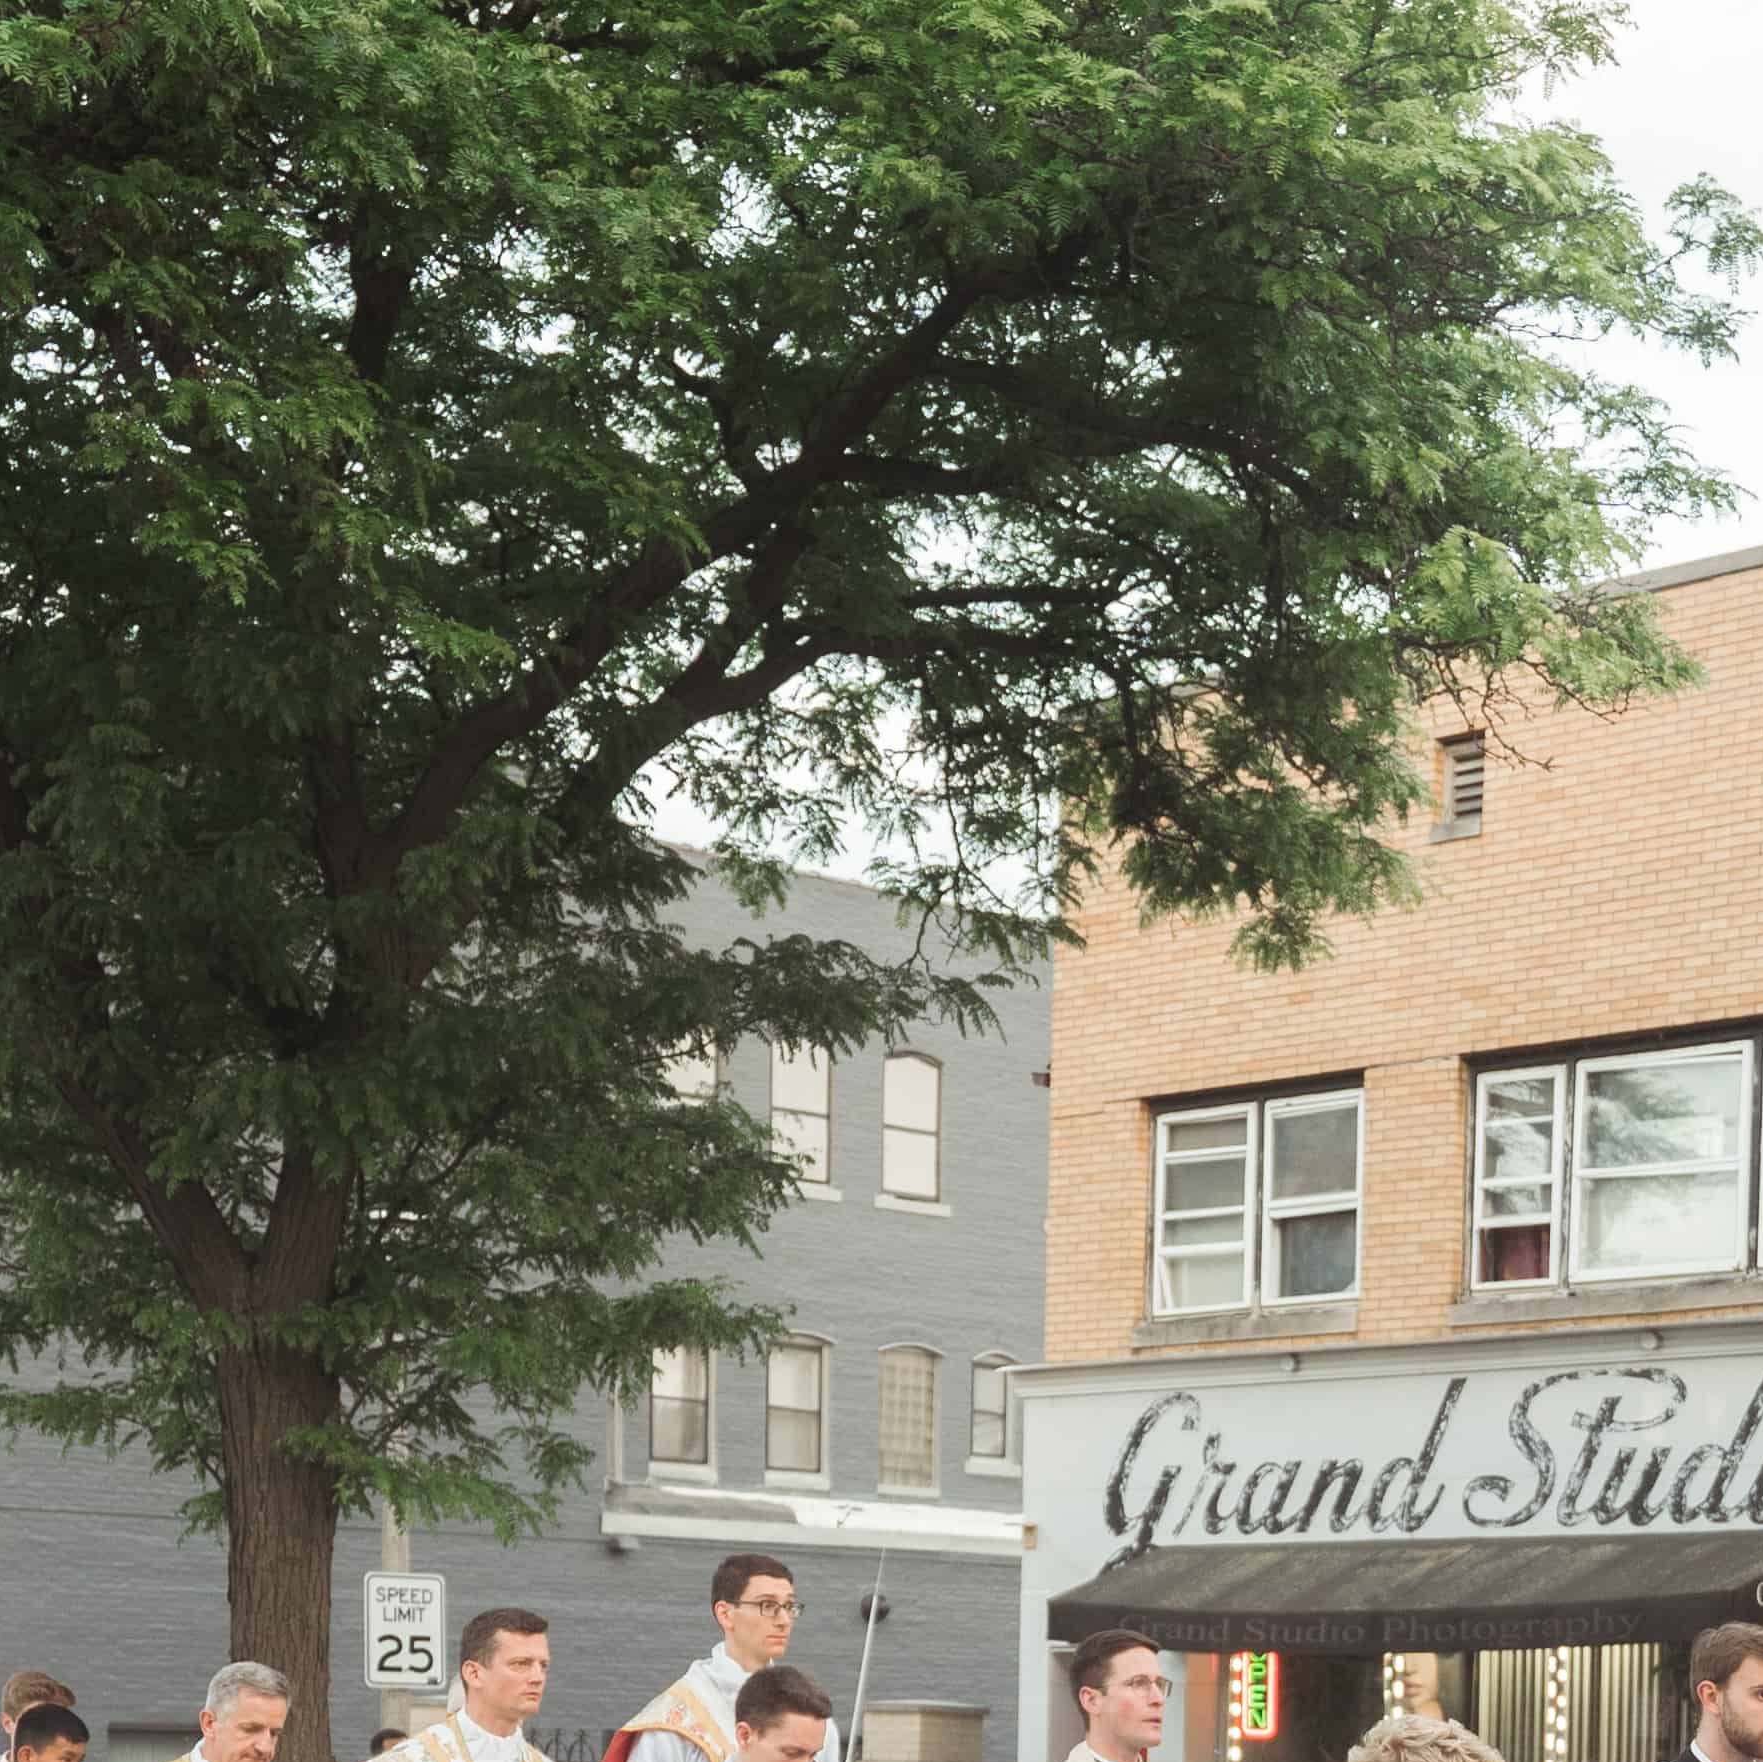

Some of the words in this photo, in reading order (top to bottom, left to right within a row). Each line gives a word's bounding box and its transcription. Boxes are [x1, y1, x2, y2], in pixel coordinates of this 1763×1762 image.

[1096, 1377, 1468, 1575] Grand
[375, 1586, 433, 1605] SPEED
[382, 1607, 425, 1623] LIMIT
[1241, 1616, 1366, 1644] Studio
[1381, 1602, 1645, 1649] Photography
[377, 1633, 434, 1673] 25
